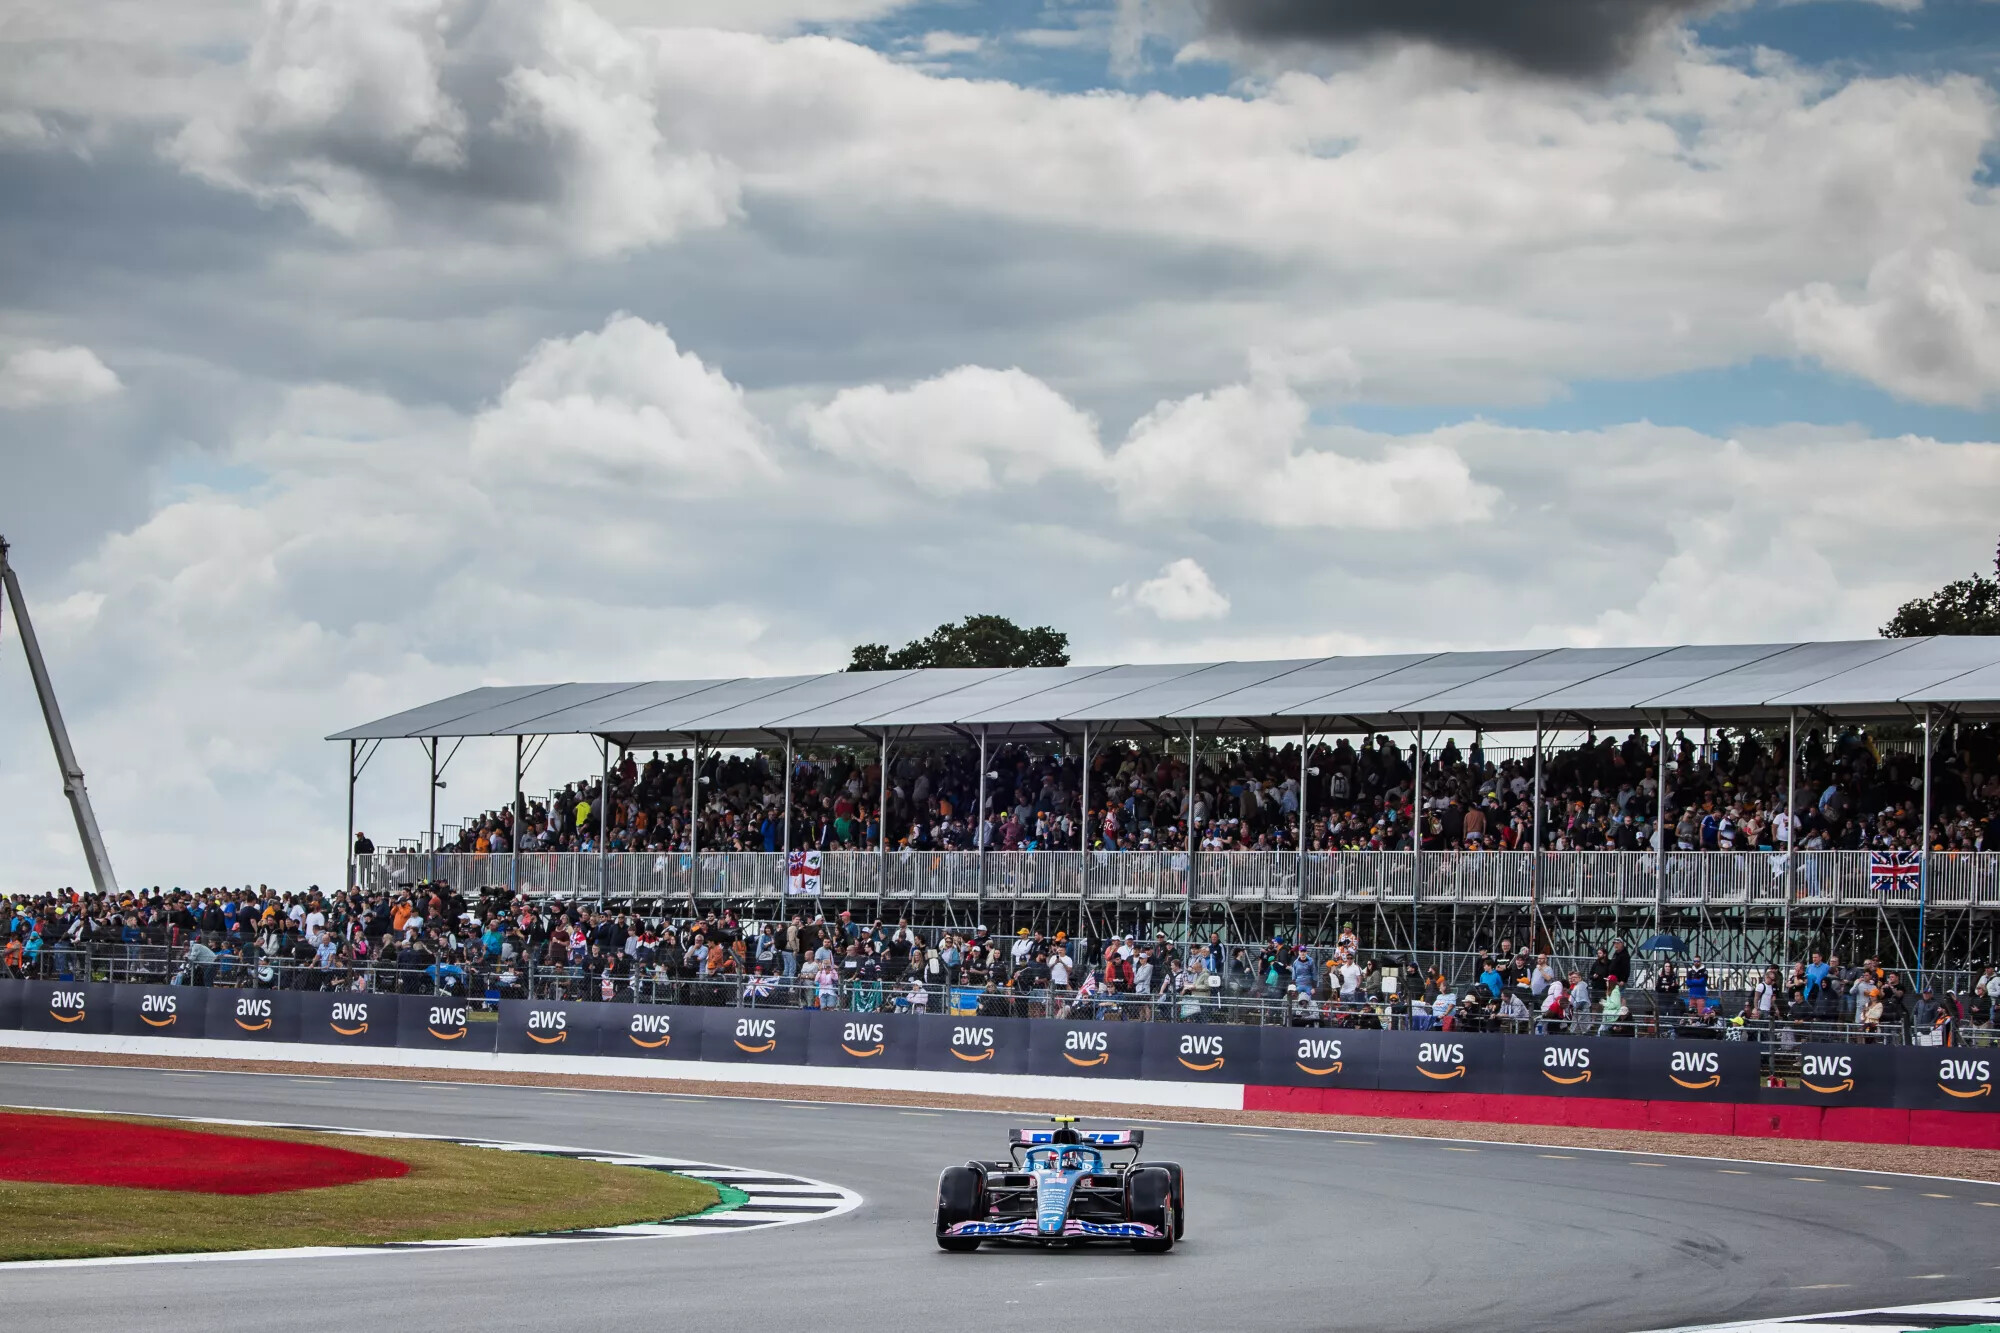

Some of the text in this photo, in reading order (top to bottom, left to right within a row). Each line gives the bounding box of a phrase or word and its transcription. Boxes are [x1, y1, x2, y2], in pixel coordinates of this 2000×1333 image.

[1875, 875, 1915, 884] GEORGE
[51, 990, 85, 1009] aws
[141, 994, 177, 1013] aws
[236, 998, 272, 1017] aws
[331, 1002, 368, 1022] aws
[429, 1005, 468, 1026] aws
[528, 1010, 567, 1030] aws
[630, 1013, 671, 1034] aws
[735, 1018, 776, 1038] aws
[843, 1022, 884, 1043] aws
[952, 1026, 994, 1047] aws
[1064, 1030, 1108, 1051] aws
[1179, 1034, 1223, 1056] aws
[1297, 1038, 1342, 1060] aws
[1417, 1042, 1464, 1064] aws
[1543, 1046, 1590, 1068] aws
[1670, 1051, 1719, 1073] aws
[1802, 1055, 1852, 1077] aws
[1939, 1059, 1990, 1082] aws
[1032, 1133, 1120, 1144] BT
